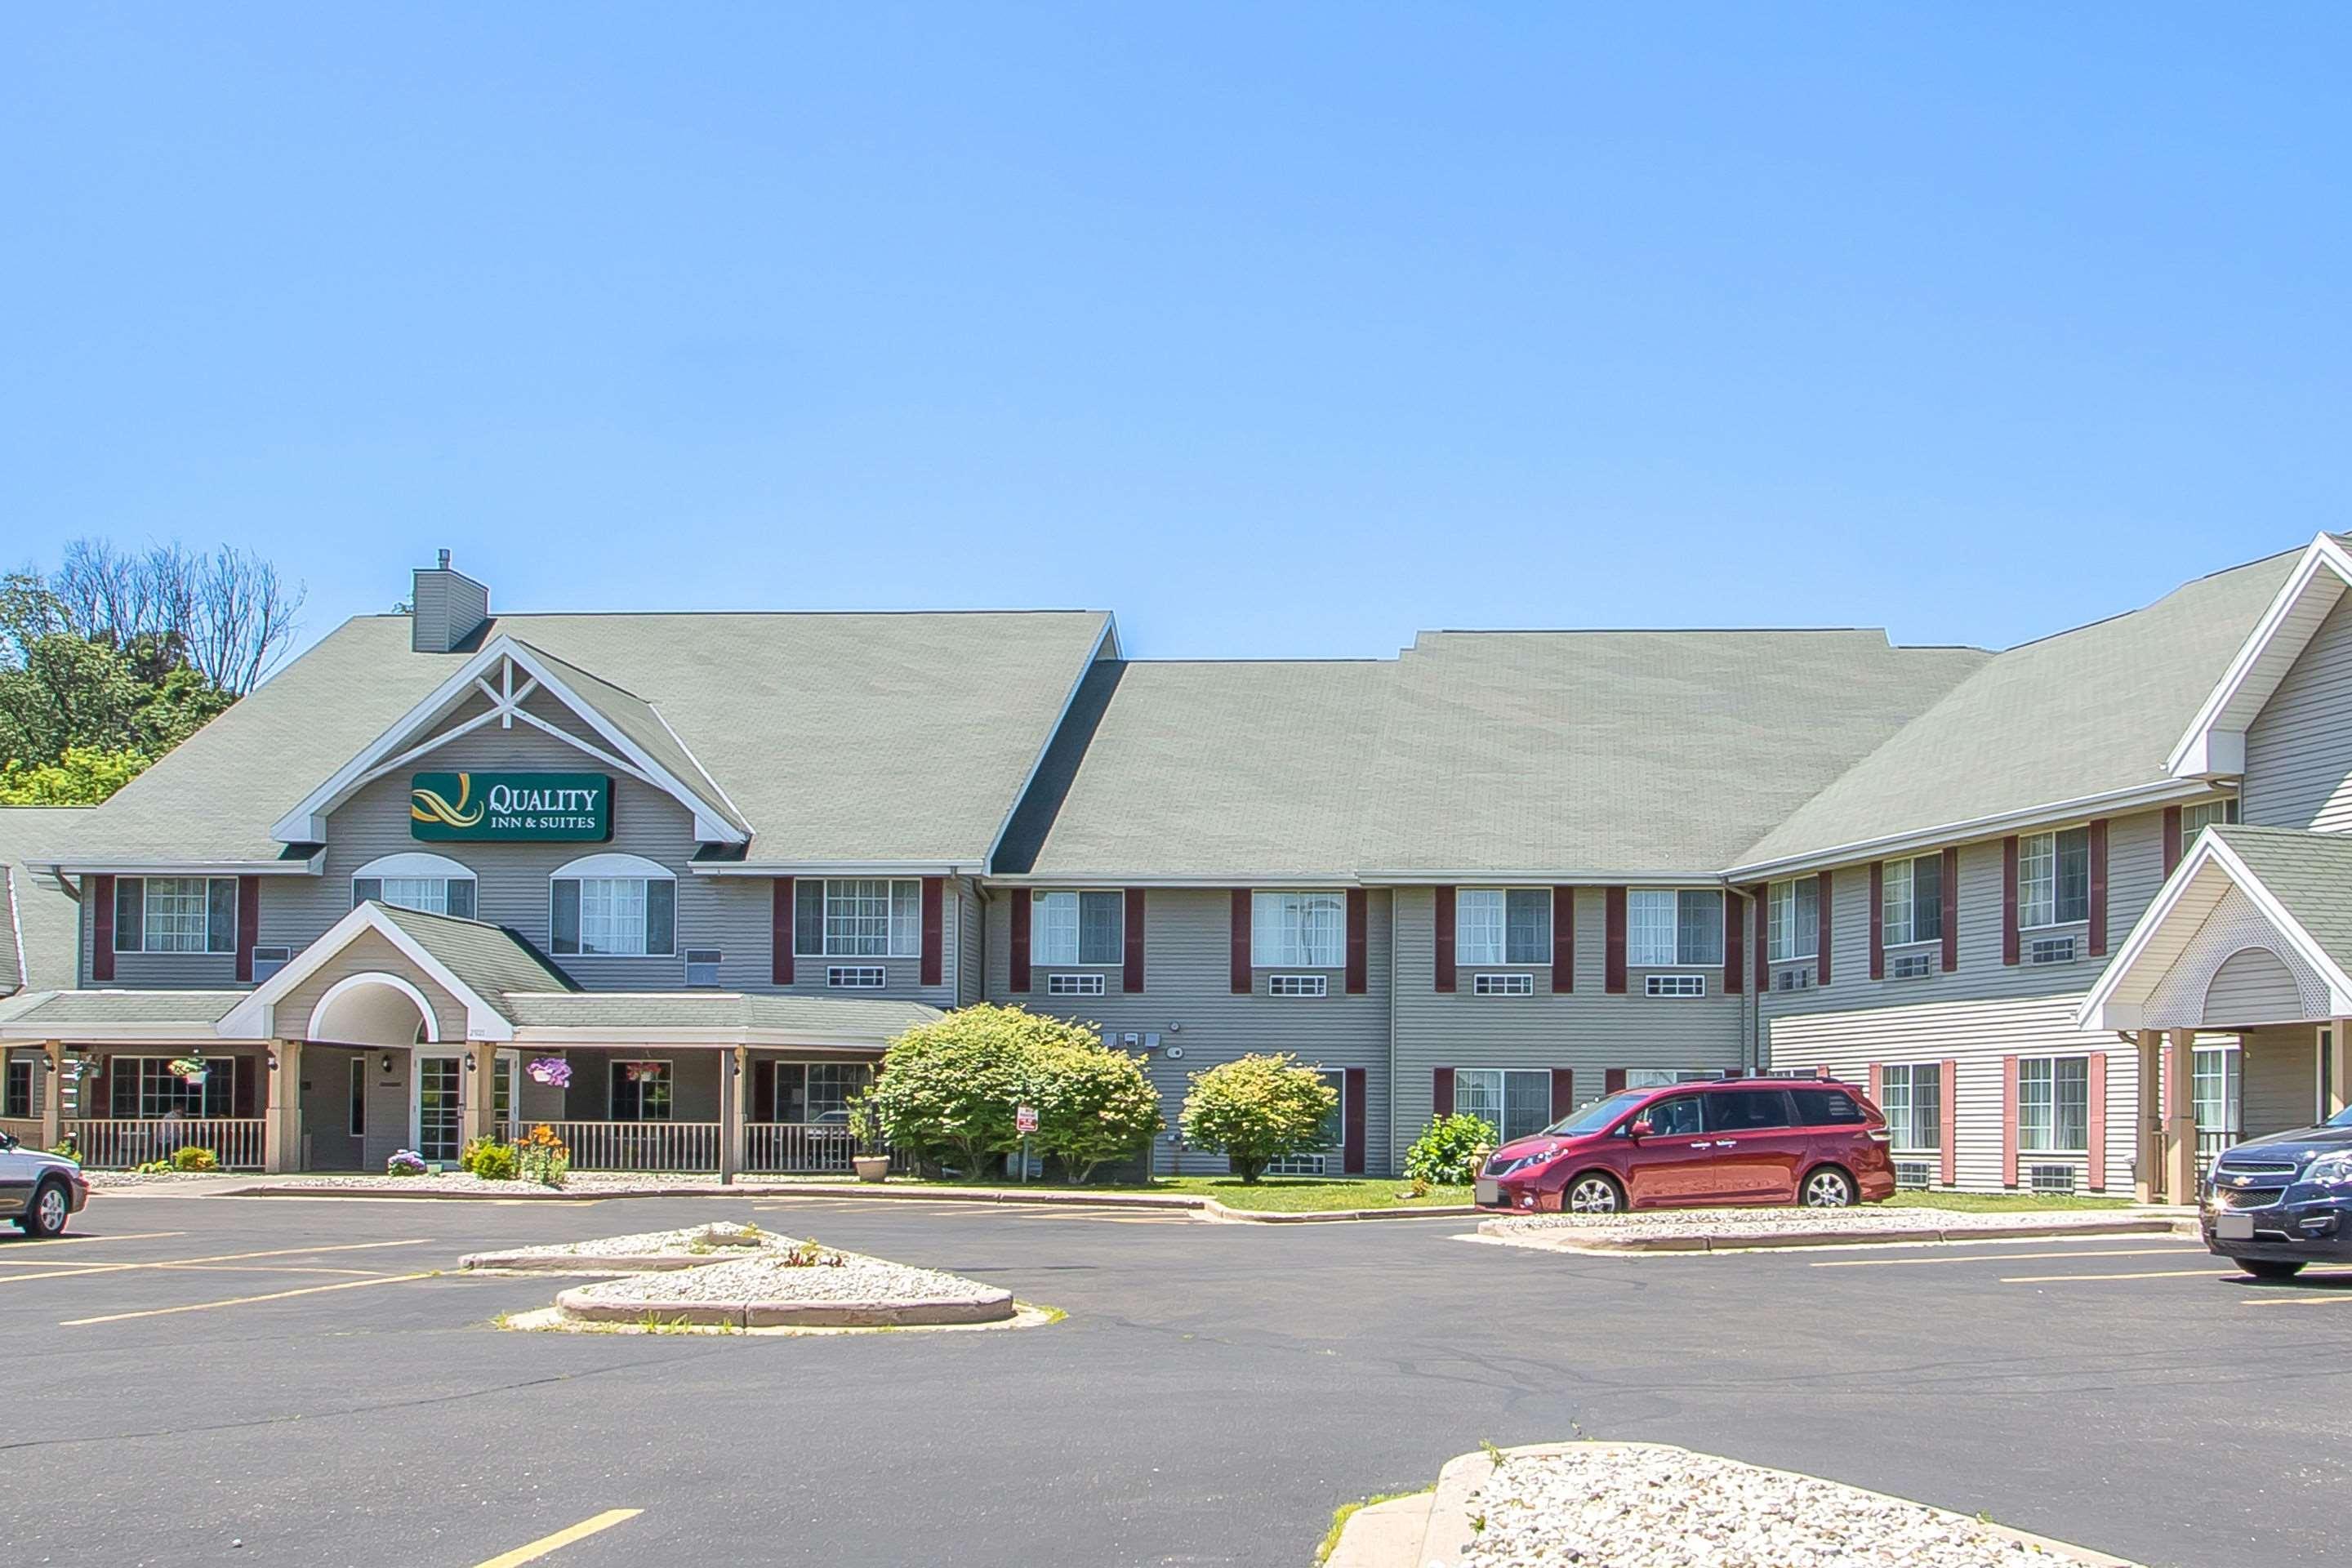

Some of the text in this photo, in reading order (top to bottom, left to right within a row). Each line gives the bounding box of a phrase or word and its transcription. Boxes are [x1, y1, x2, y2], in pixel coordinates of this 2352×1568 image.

[489, 784, 599, 814] QUALITY
[491, 817, 595, 828] INN & SUITES
